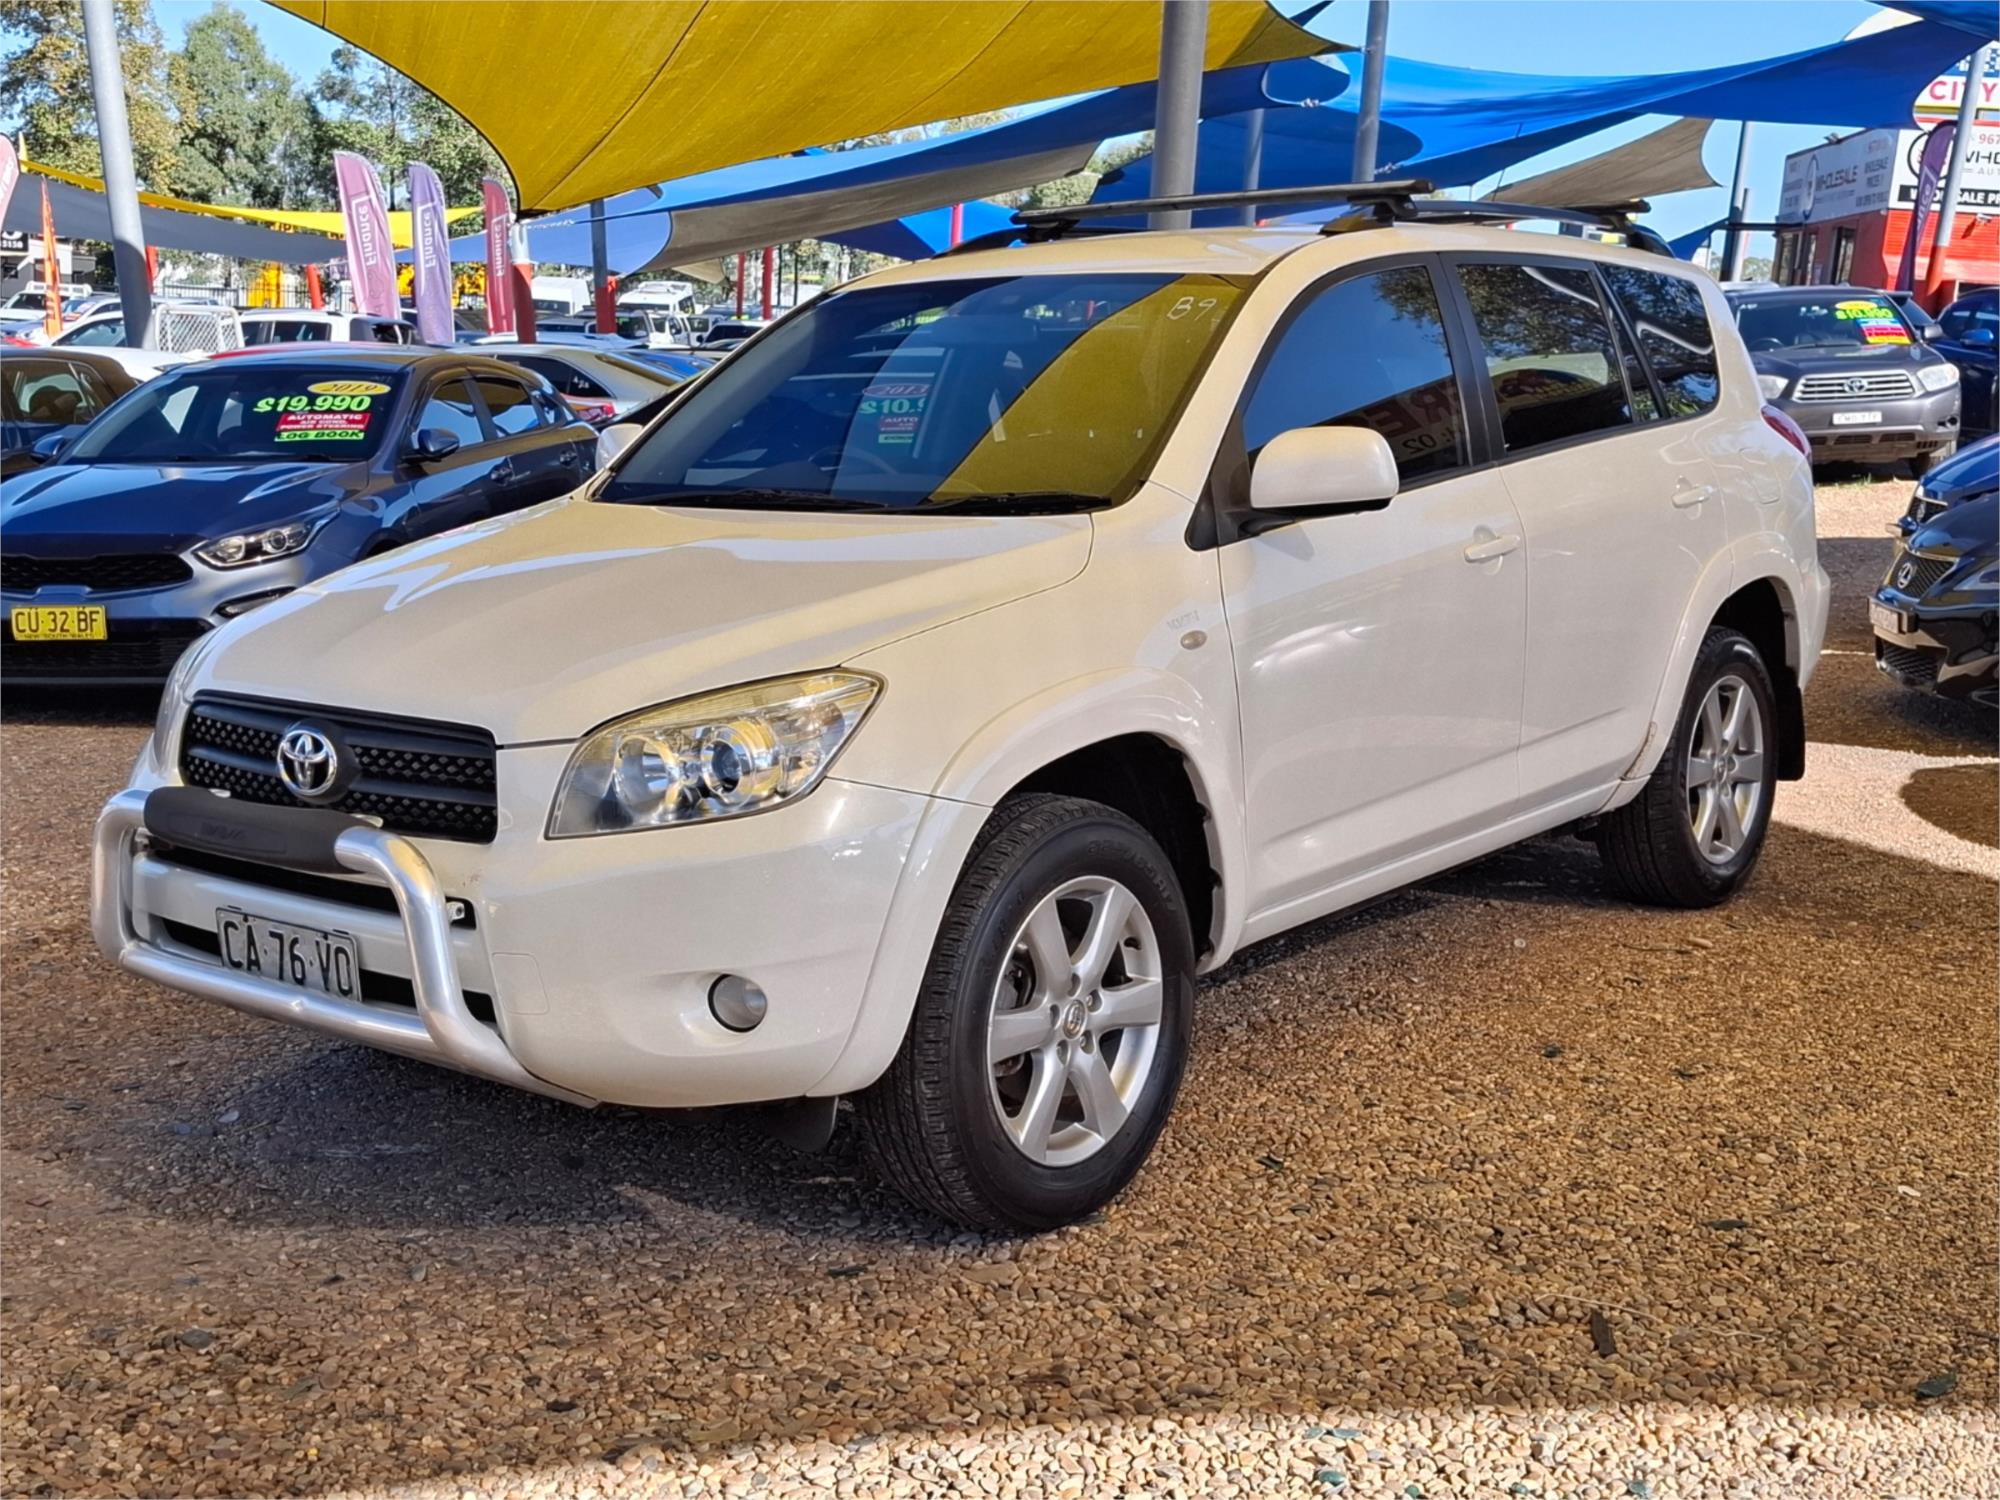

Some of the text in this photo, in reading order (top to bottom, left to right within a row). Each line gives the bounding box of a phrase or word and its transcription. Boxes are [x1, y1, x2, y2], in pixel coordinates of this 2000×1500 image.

[320, 383, 379, 392] 2019
[287, 413, 363, 421] AUTOMATIC
[314, 430, 362, 439] BOOK
